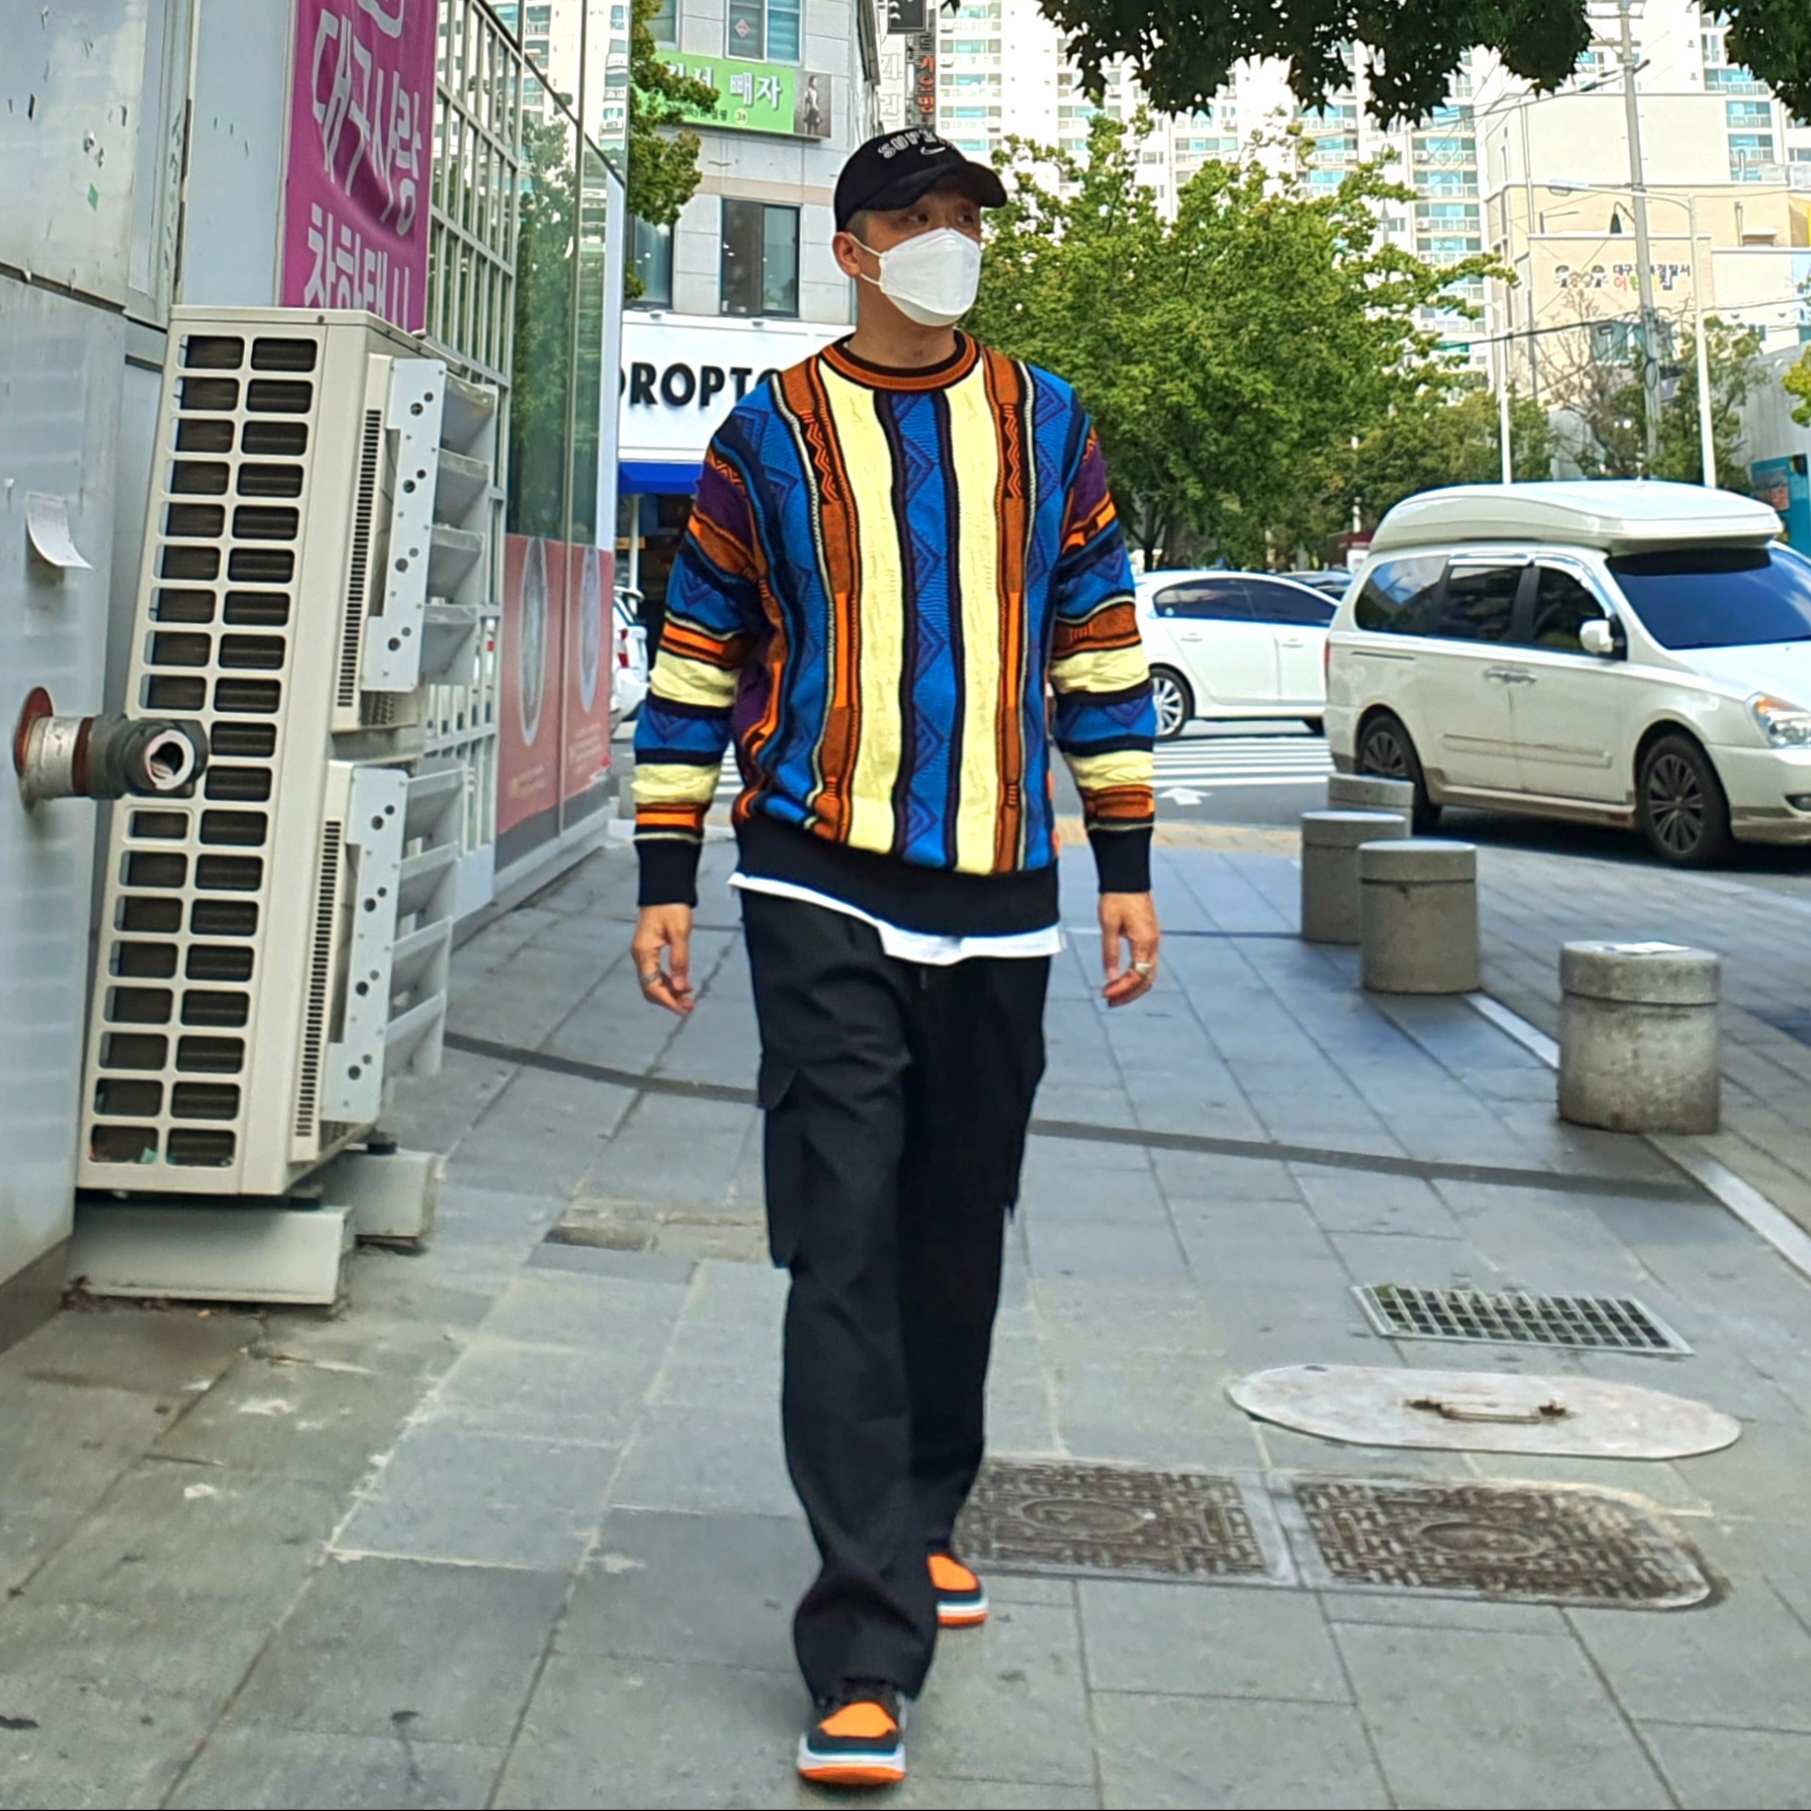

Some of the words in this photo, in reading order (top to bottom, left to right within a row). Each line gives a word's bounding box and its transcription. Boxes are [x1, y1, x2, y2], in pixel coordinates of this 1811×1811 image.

[729, 72, 782, 110] 빼자
[312, 8, 422, 236] 대구사랑
[620, 361, 783, 408] ROPT
